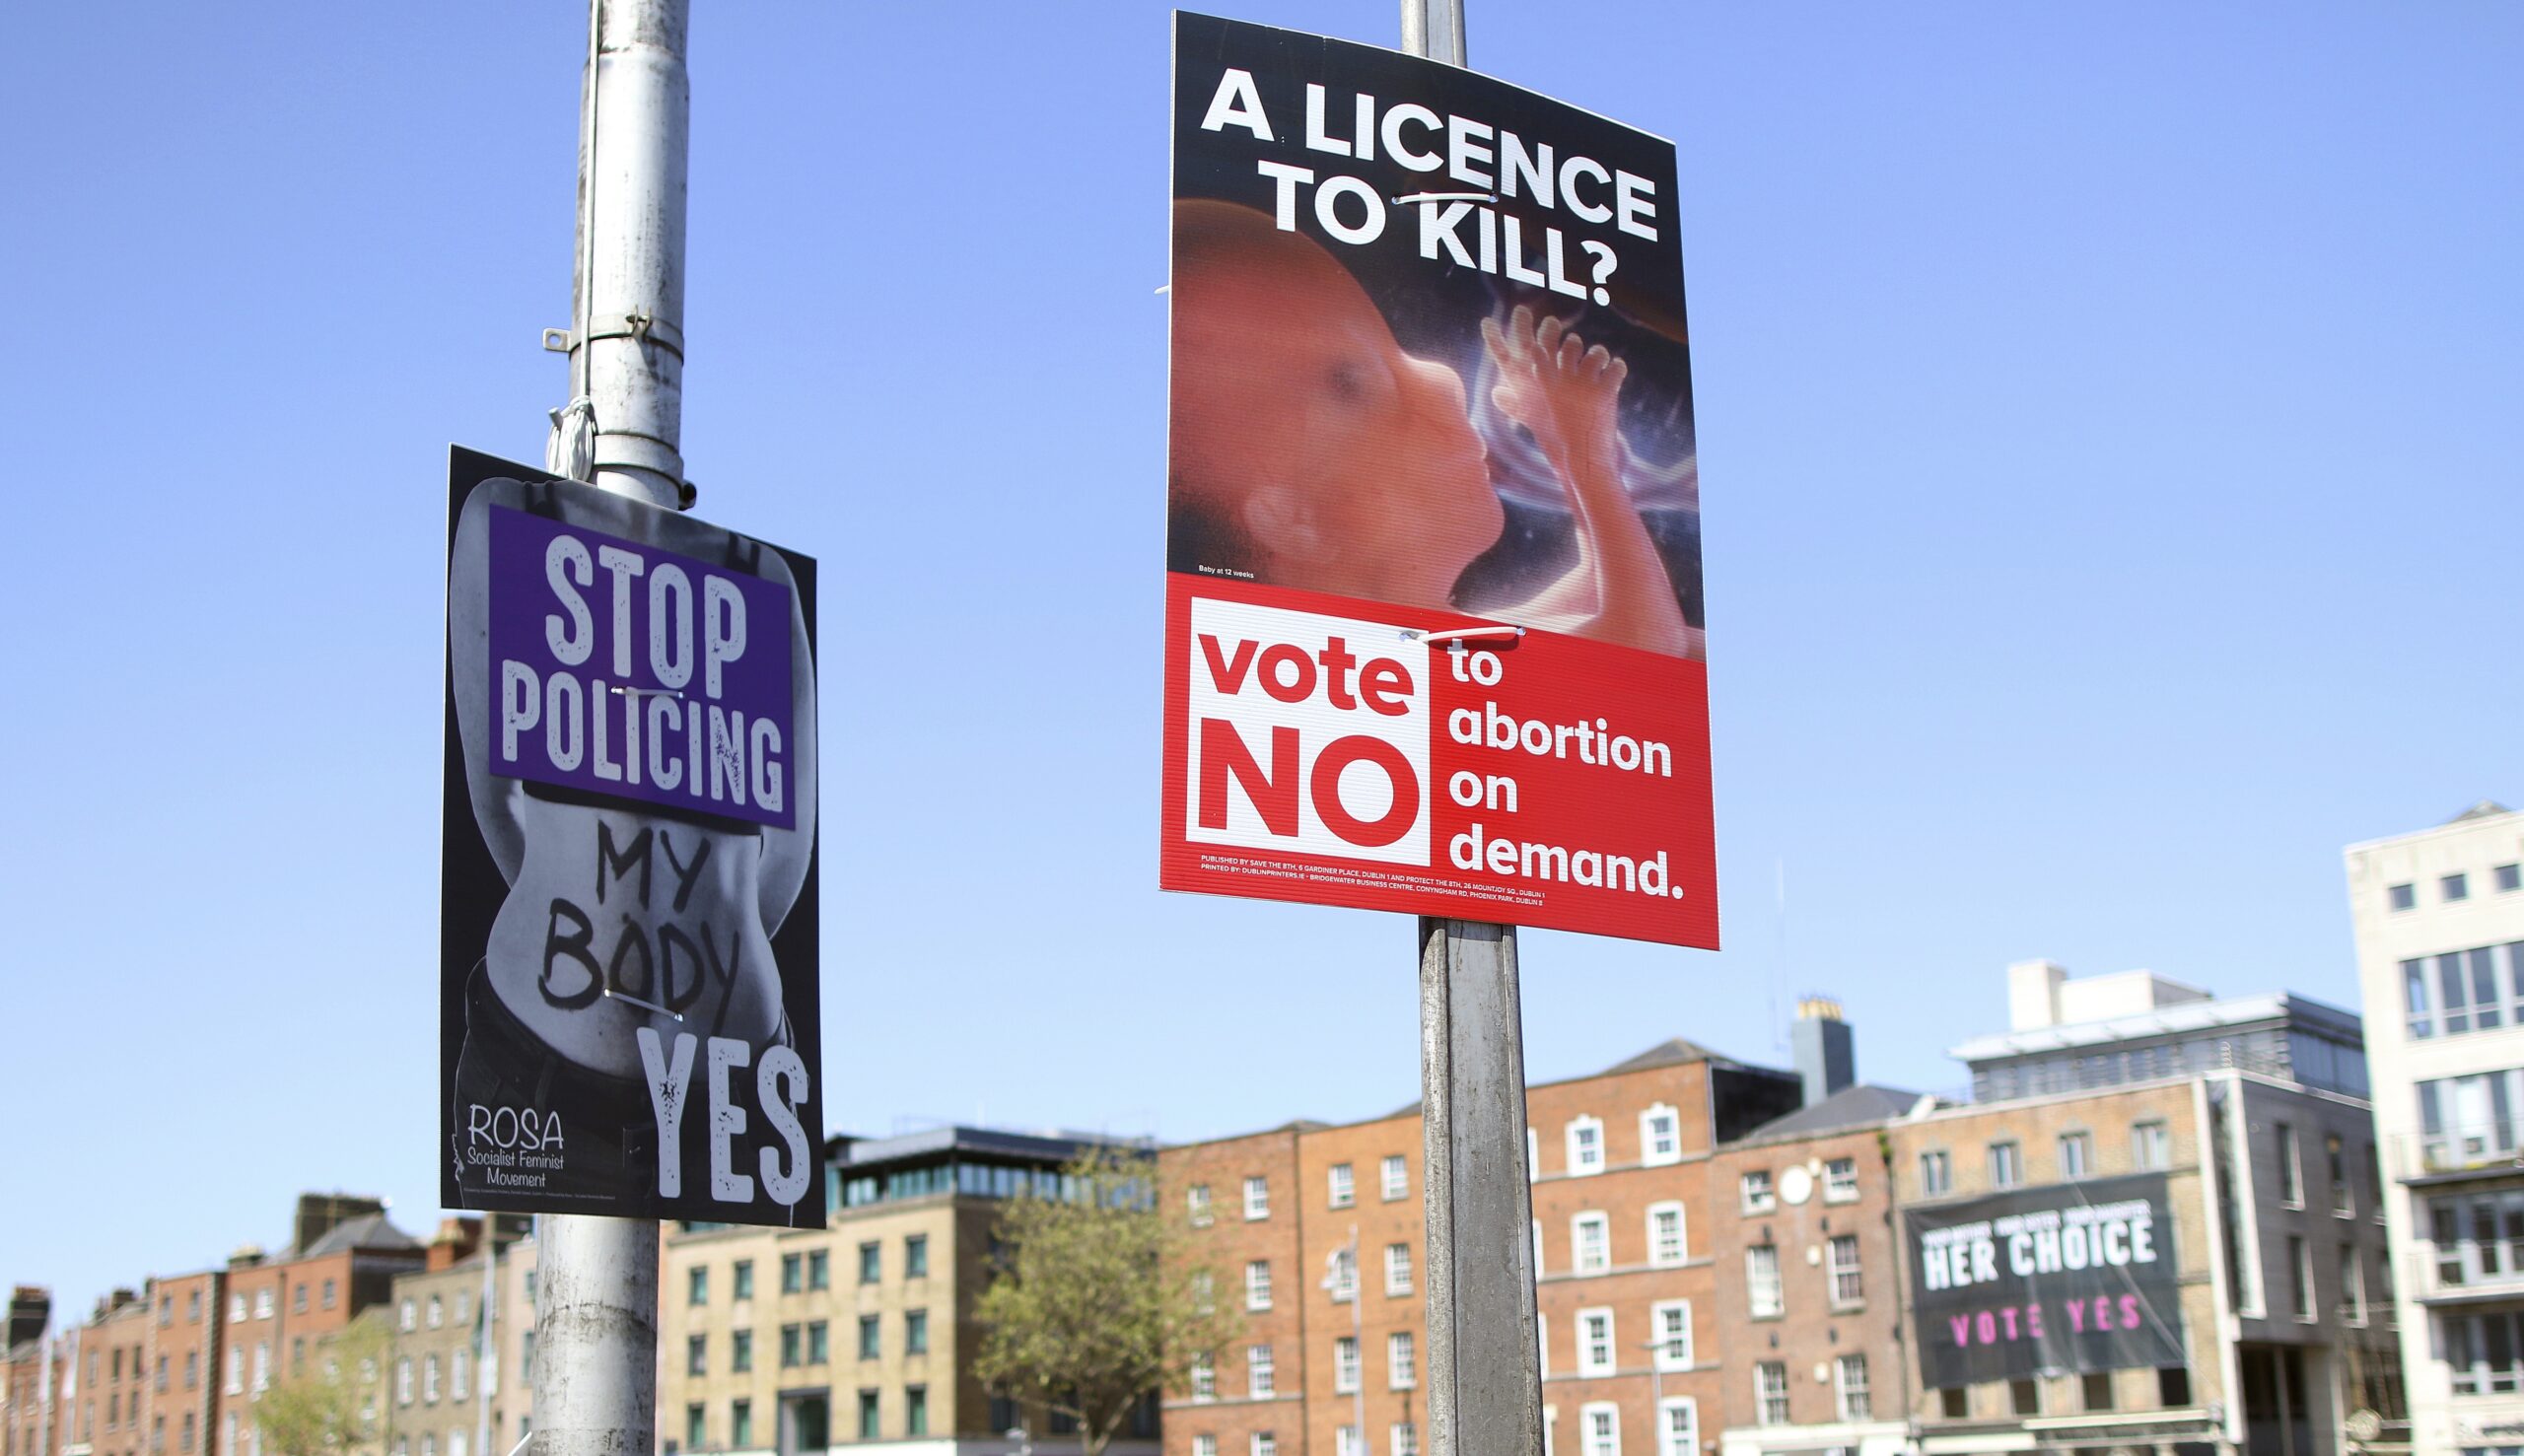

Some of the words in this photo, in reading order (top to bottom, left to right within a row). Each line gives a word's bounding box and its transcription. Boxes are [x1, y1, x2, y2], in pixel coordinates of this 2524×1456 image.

[1200, 68, 1275, 142] A
[1306, 83, 1658, 243] LICENCE
[1257, 160, 1386, 244] TO
[1420, 191, 1618, 307] KILL?
[1199, 564, 1215, 574] Baby
[1232, 570, 1254, 579] weeks
[545, 534, 746, 699] STOP
[1197, 633, 1415, 717] vote
[1446, 638, 1503, 686] to
[502, 659, 783, 812] POLICING
[1448, 701, 1672, 778] abortion
[1199, 717, 1421, 848] NO
[1448, 770, 1517, 812] on
[596, 819, 711, 912] MY
[1201, 855, 1238, 865] PUBLISHED
[1304, 866, 1338, 874] GARDINER
[1339, 868, 1361, 877] PLACE,
[1406, 876, 1434, 885] PROTECT
[1473, 884, 1506, 893] MOUNTJOY
[1242, 867, 1304, 879] DUBLINPRINTERS.IE
[1309, 874, 1356, 884] BRIDGEWATER
[1357, 878, 1387, 887] BUSINESS
[1388, 882, 1415, 891] CENTRE,
[1416, 885, 1457, 895] CONYNGHAM
[1448, 824, 1684, 900] demand.
[538, 898, 740, 1035] BODY
[468, 1103, 564, 1150] ROSA
[636, 1026, 811, 1206] YES
[467, 1145, 516, 1167] Socialist
[519, 1149, 564, 1170] Feminist
[487, 1167, 546, 1188] Movement
[1923, 1239, 1999, 1291] HER
[2008, 1215, 2157, 1277] CHOICE
[1949, 1302, 2045, 1348] VOTE
[2067, 1293, 2140, 1334] YES
